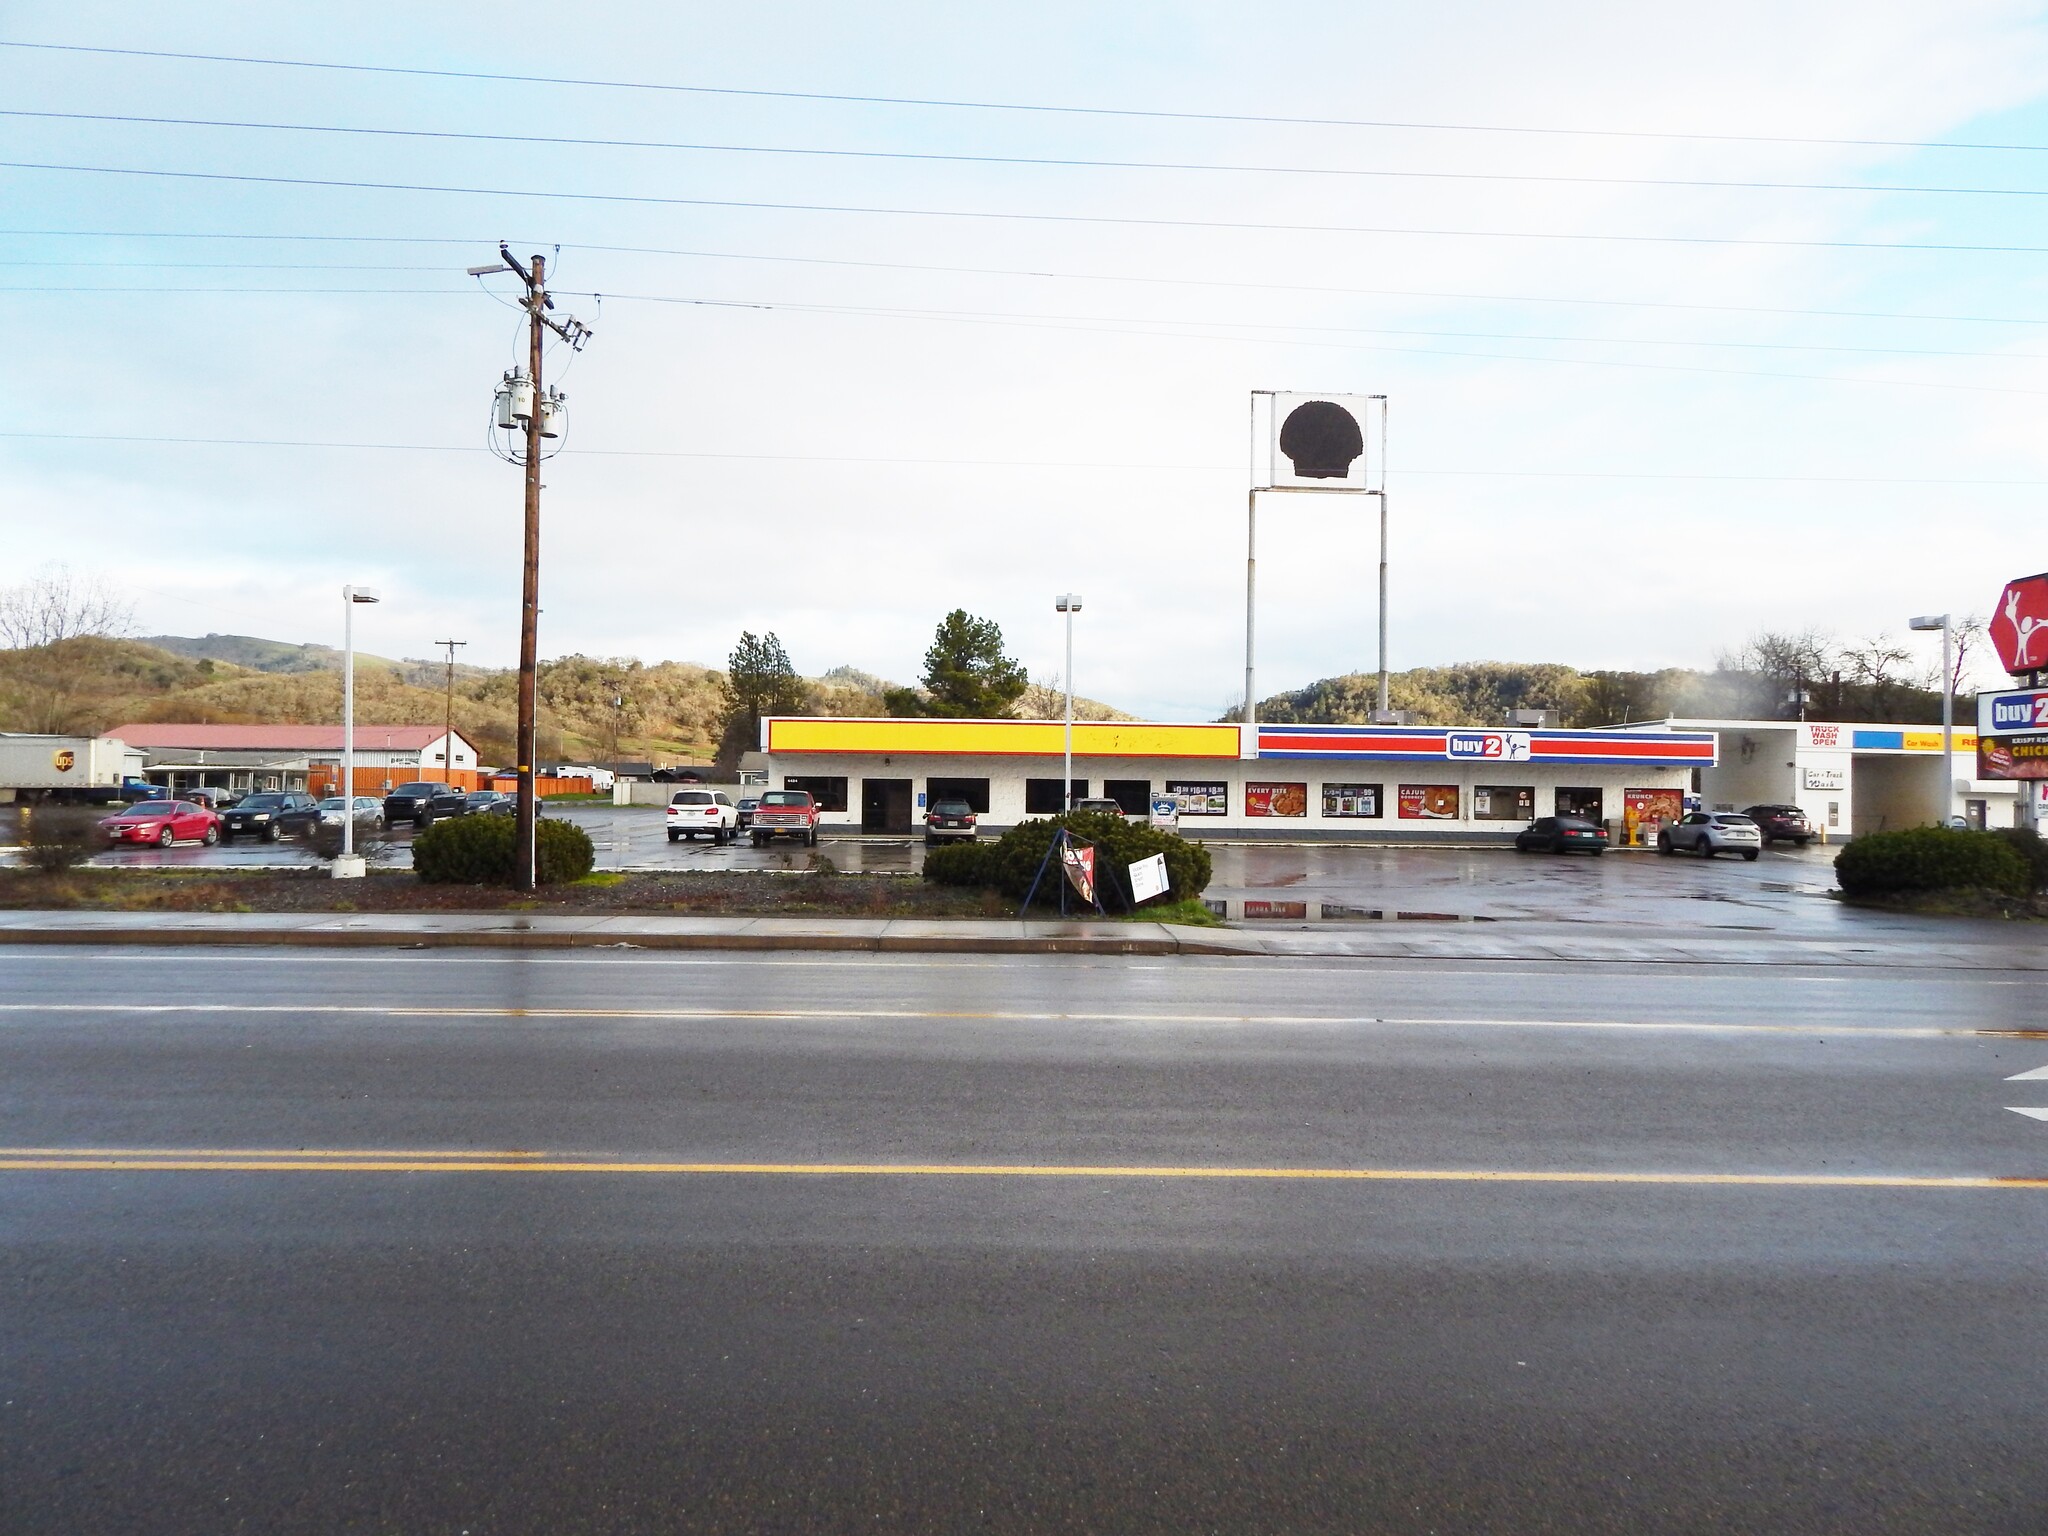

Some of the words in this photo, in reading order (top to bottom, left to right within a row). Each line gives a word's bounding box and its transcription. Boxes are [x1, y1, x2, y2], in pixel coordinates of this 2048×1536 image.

[1812, 738, 1837, 746] OPEN
[1906, 739, 1918, 747] Car
[56, 756, 74, 770] ups
